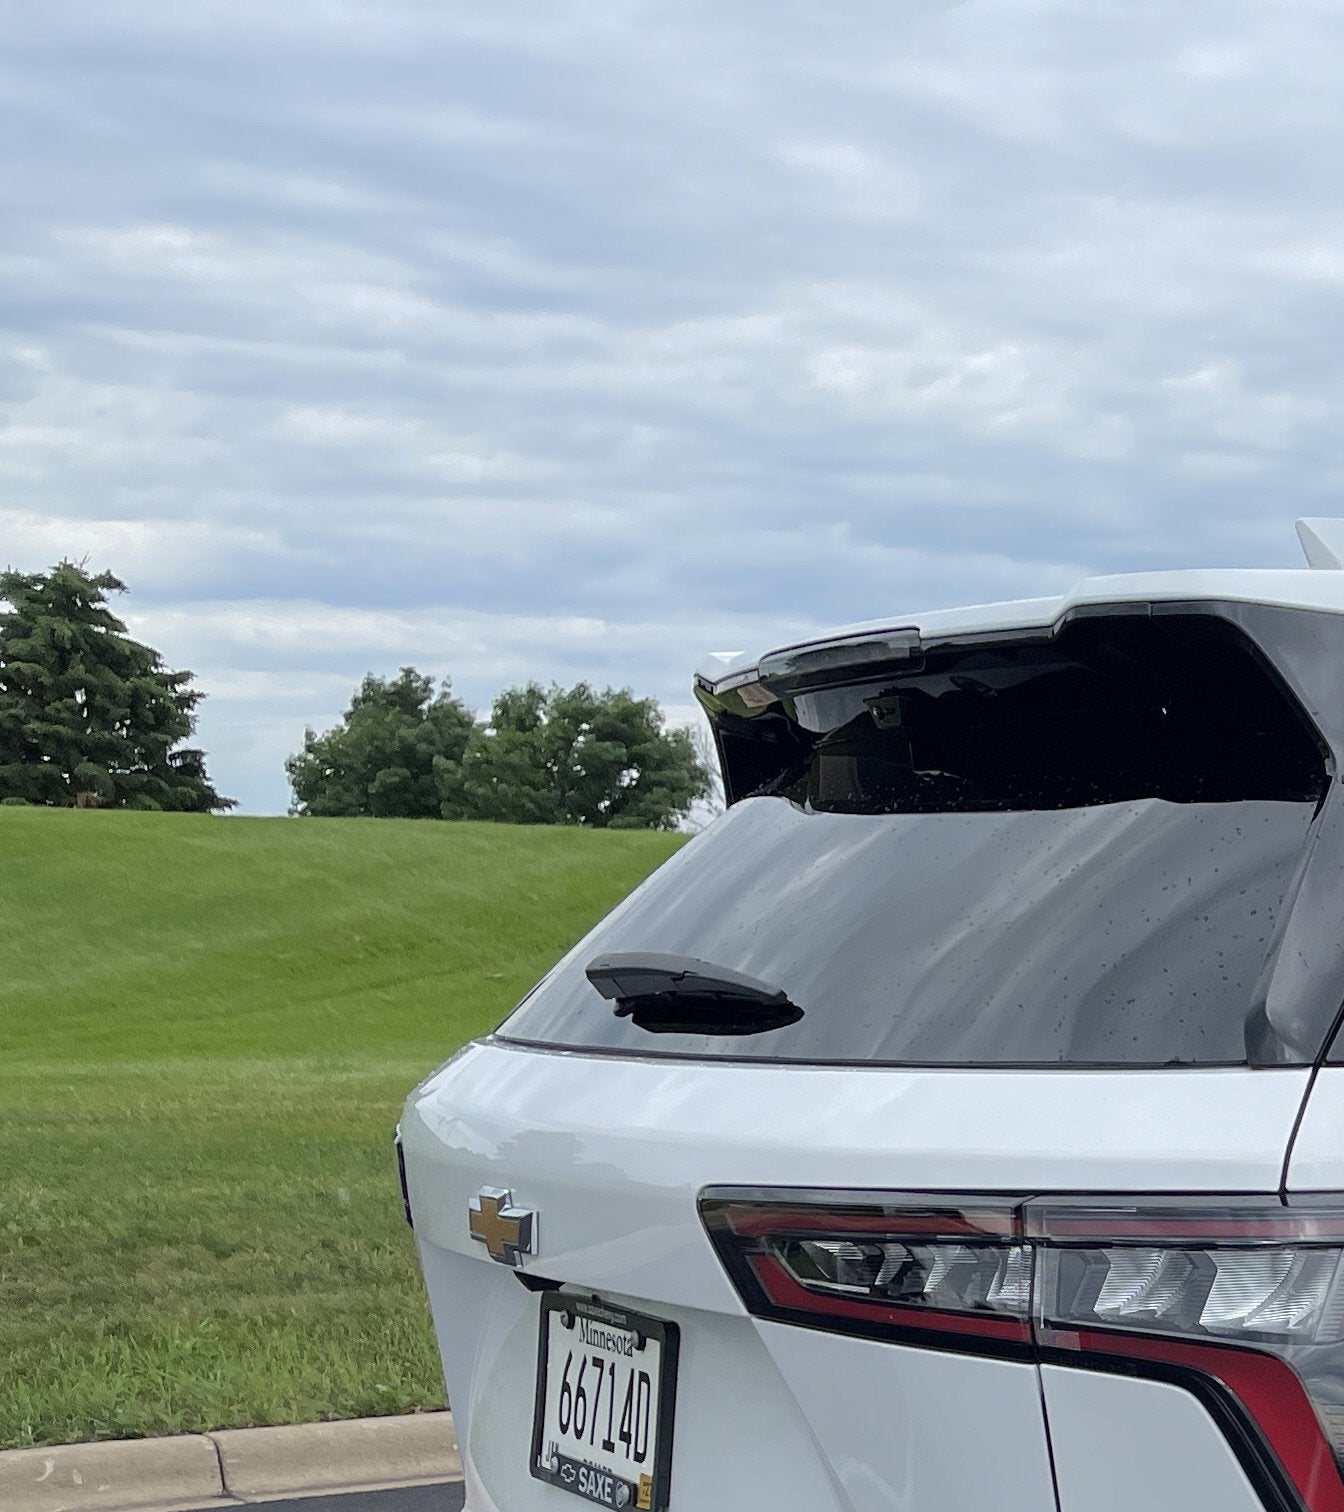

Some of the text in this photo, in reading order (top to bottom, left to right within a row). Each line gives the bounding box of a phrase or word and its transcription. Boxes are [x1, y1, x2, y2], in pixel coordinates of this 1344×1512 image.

[579, 1316, 633, 1357] Minnesota
[559, 1350, 651, 1464] 66714D
[578, 1467, 614, 1504] SAXE
